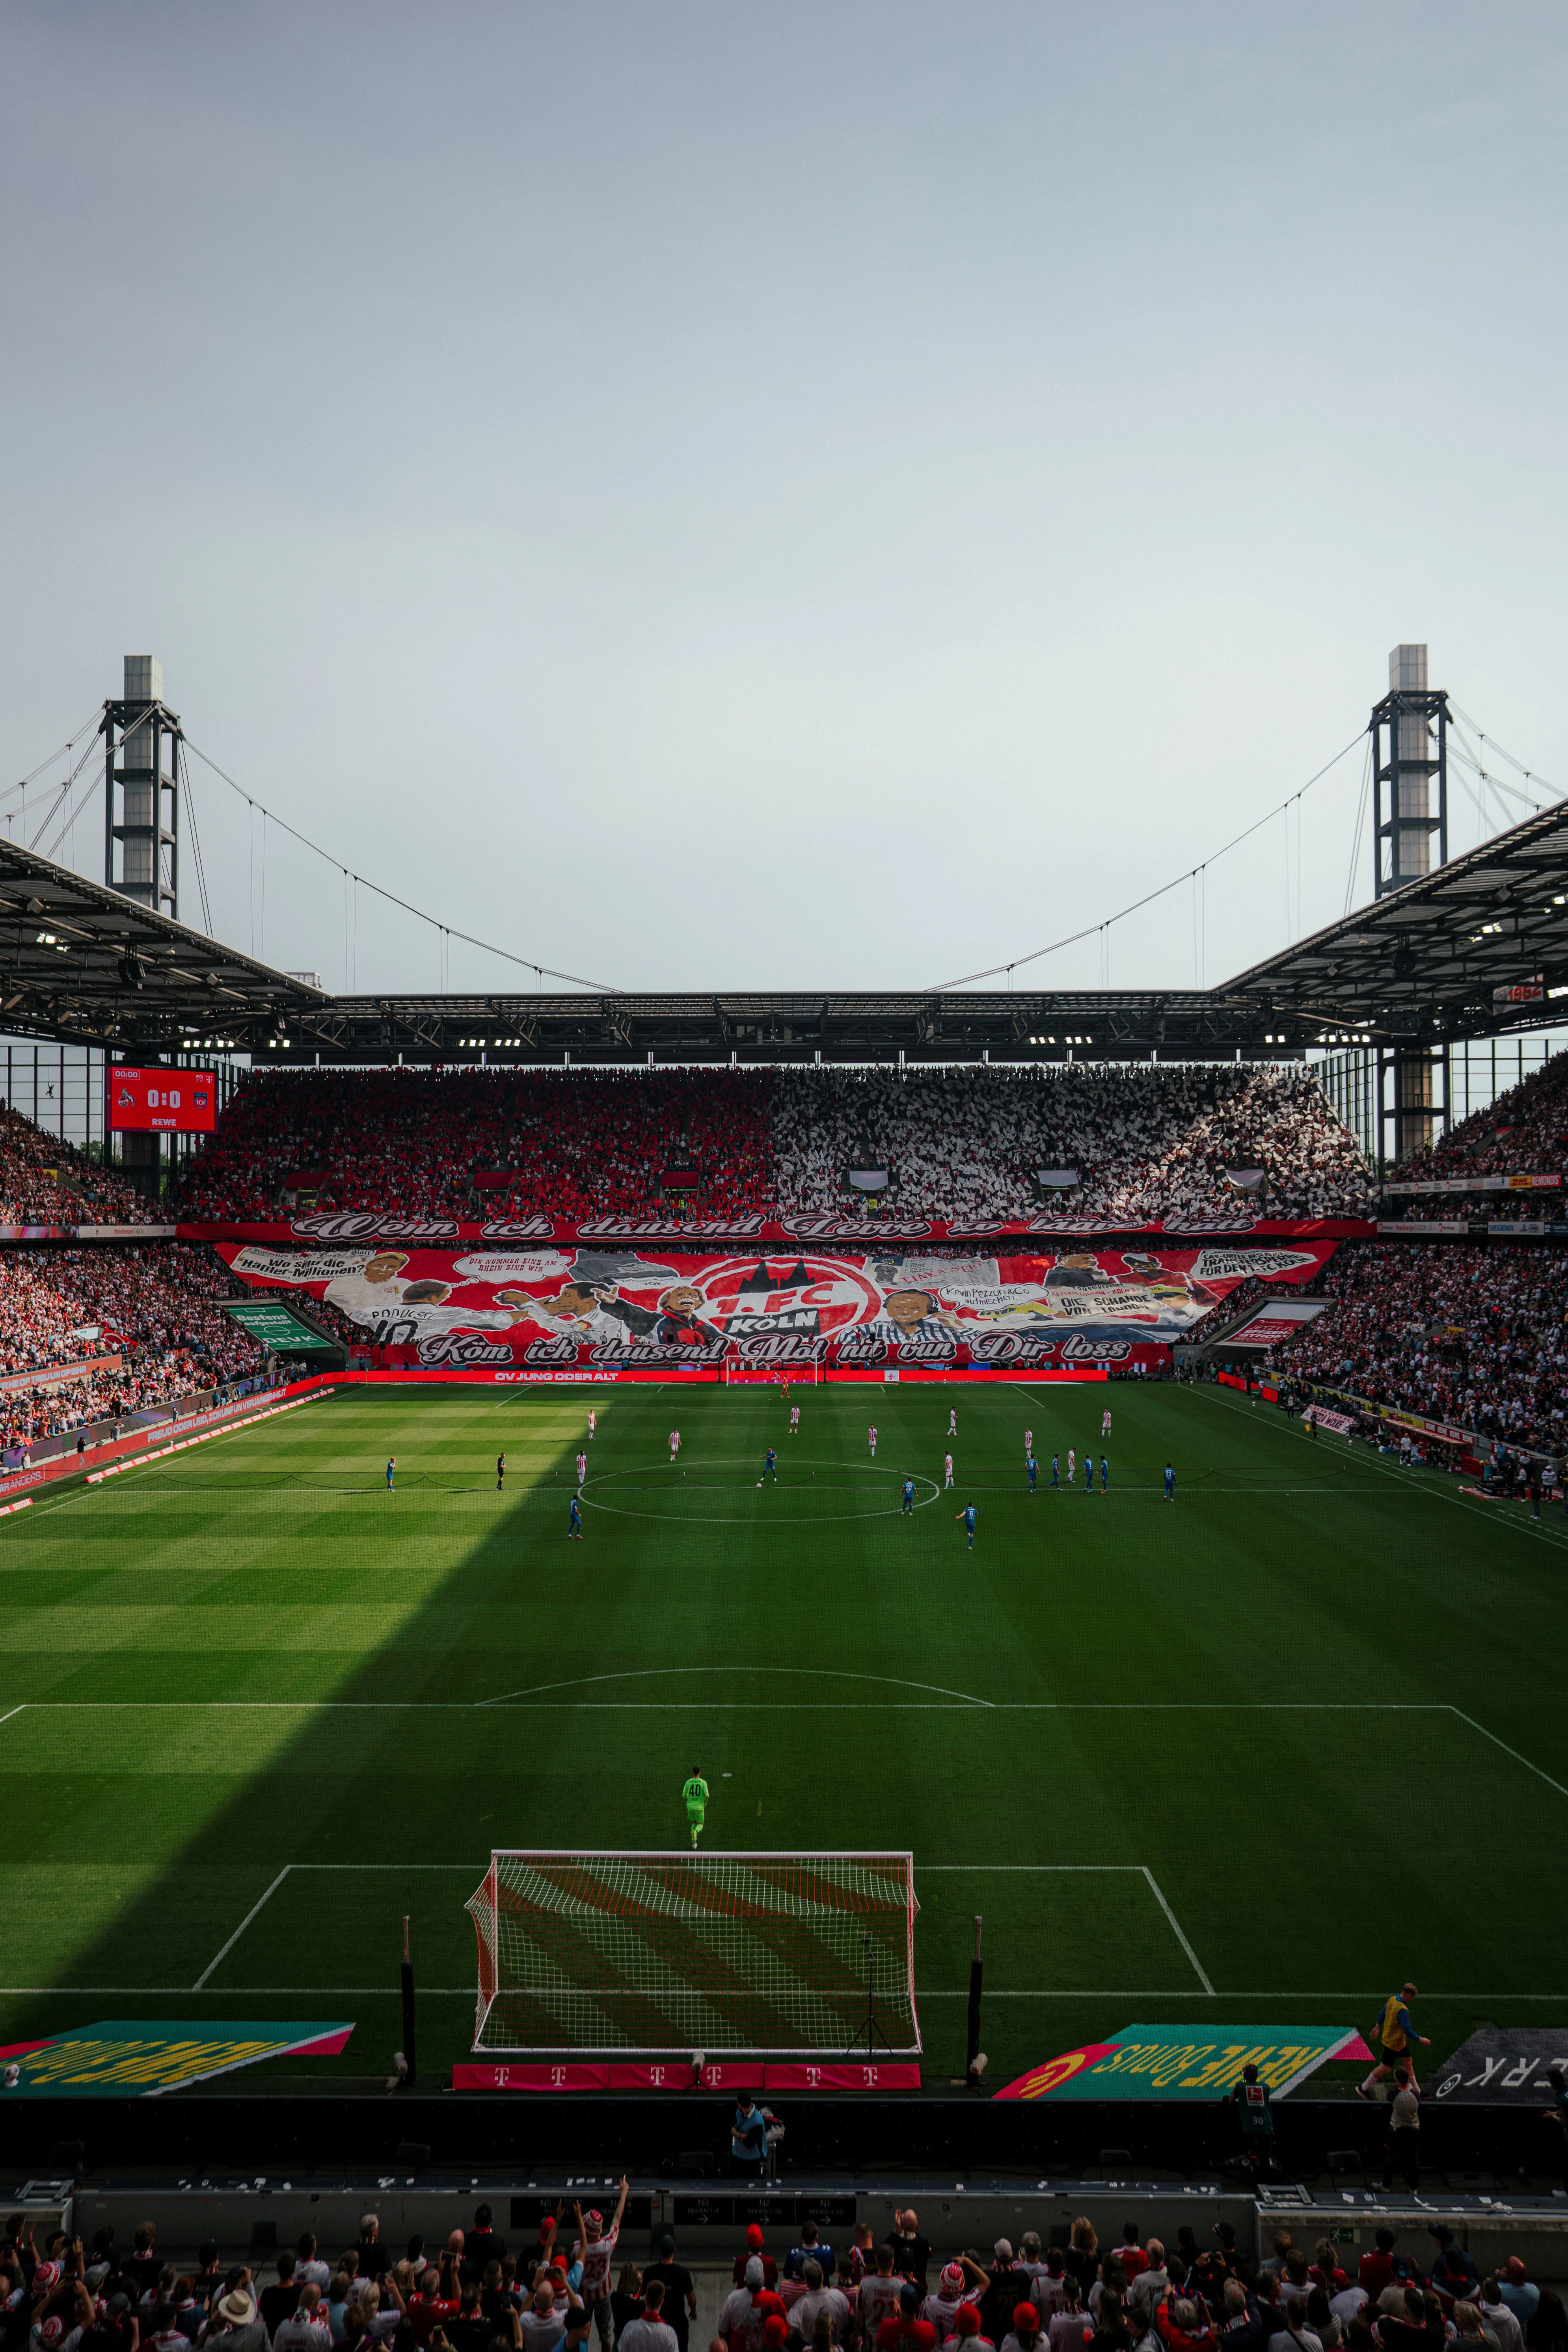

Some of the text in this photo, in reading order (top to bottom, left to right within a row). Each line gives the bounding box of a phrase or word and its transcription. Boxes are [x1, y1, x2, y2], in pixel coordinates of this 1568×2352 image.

[148, 1089, 180, 1108] 0:0
[1532, 1175, 1559, 1185] REMONDIS
[292, 1213, 458, 1240] Wenn
[482, 1215, 554, 1238] ich
[577, 1214, 765, 1238] dausend
[947, 1221, 1004, 1237] zo
[1163, 1216, 1256, 1235] hätt
[269, 1259, 291, 1268] Wo
[323, 1259, 345, 1267] die
[1199, 1266, 1222, 1276] FÜR
[1223, 1264, 1247, 1274] DEN
[946, 1287, 971, 1297] Kevin
[1060, 1294, 1151, 1307] DIE SCHANDE
[1064, 1307, 1092, 1316] VON
[1103, 1303, 1149, 1313] LONDON
[728, 1310, 818, 1333] KÖLN
[261, 1335, 318, 1344] DEVK
[417, 1331, 1132, 1365] Köm ich dausend Mol nit vun Dir loss
[9, 1380, 19, 1389] HE
[19, 1377, 30, 1387] OP
[31, 1373, 49, 1384] TREU
[50, 1371, 60, 1380] UN
[61, 1368, 71, 1378] OP
[71, 1365, 86, 1375] IEHR
[147, 1426, 173, 1443] FREUD
[173, 1420, 192, 1435] ODER
[192, 1414, 209, 1428] LEID,
[209, 1408, 233, 1422] ZOKUNF
[234, 1402, 242, 1413] UN
[1324, 1414, 1344, 1429] WOLKE
[1426, 1422, 1436, 1432] REWE
[1438, 1426, 1448, 1436] REWE
[1449, 1430, 1460, 1440] REWE
[1462, 1434, 1473, 1444] REWE
[9, 1471, 43, 1490] ANDERS.
[13, 1499, 30, 1510] DERTOUR
[689, 1784, 701, 1797] 40
[59, 2041, 289, 2084] REWE
[1092, 2044, 1325, 2088] REWE Bonus
[1252, 2116, 1264, 2125] 30
[584, 2259, 607, 2278] 23
[284, 2338, 307, 2346] THOMAS
